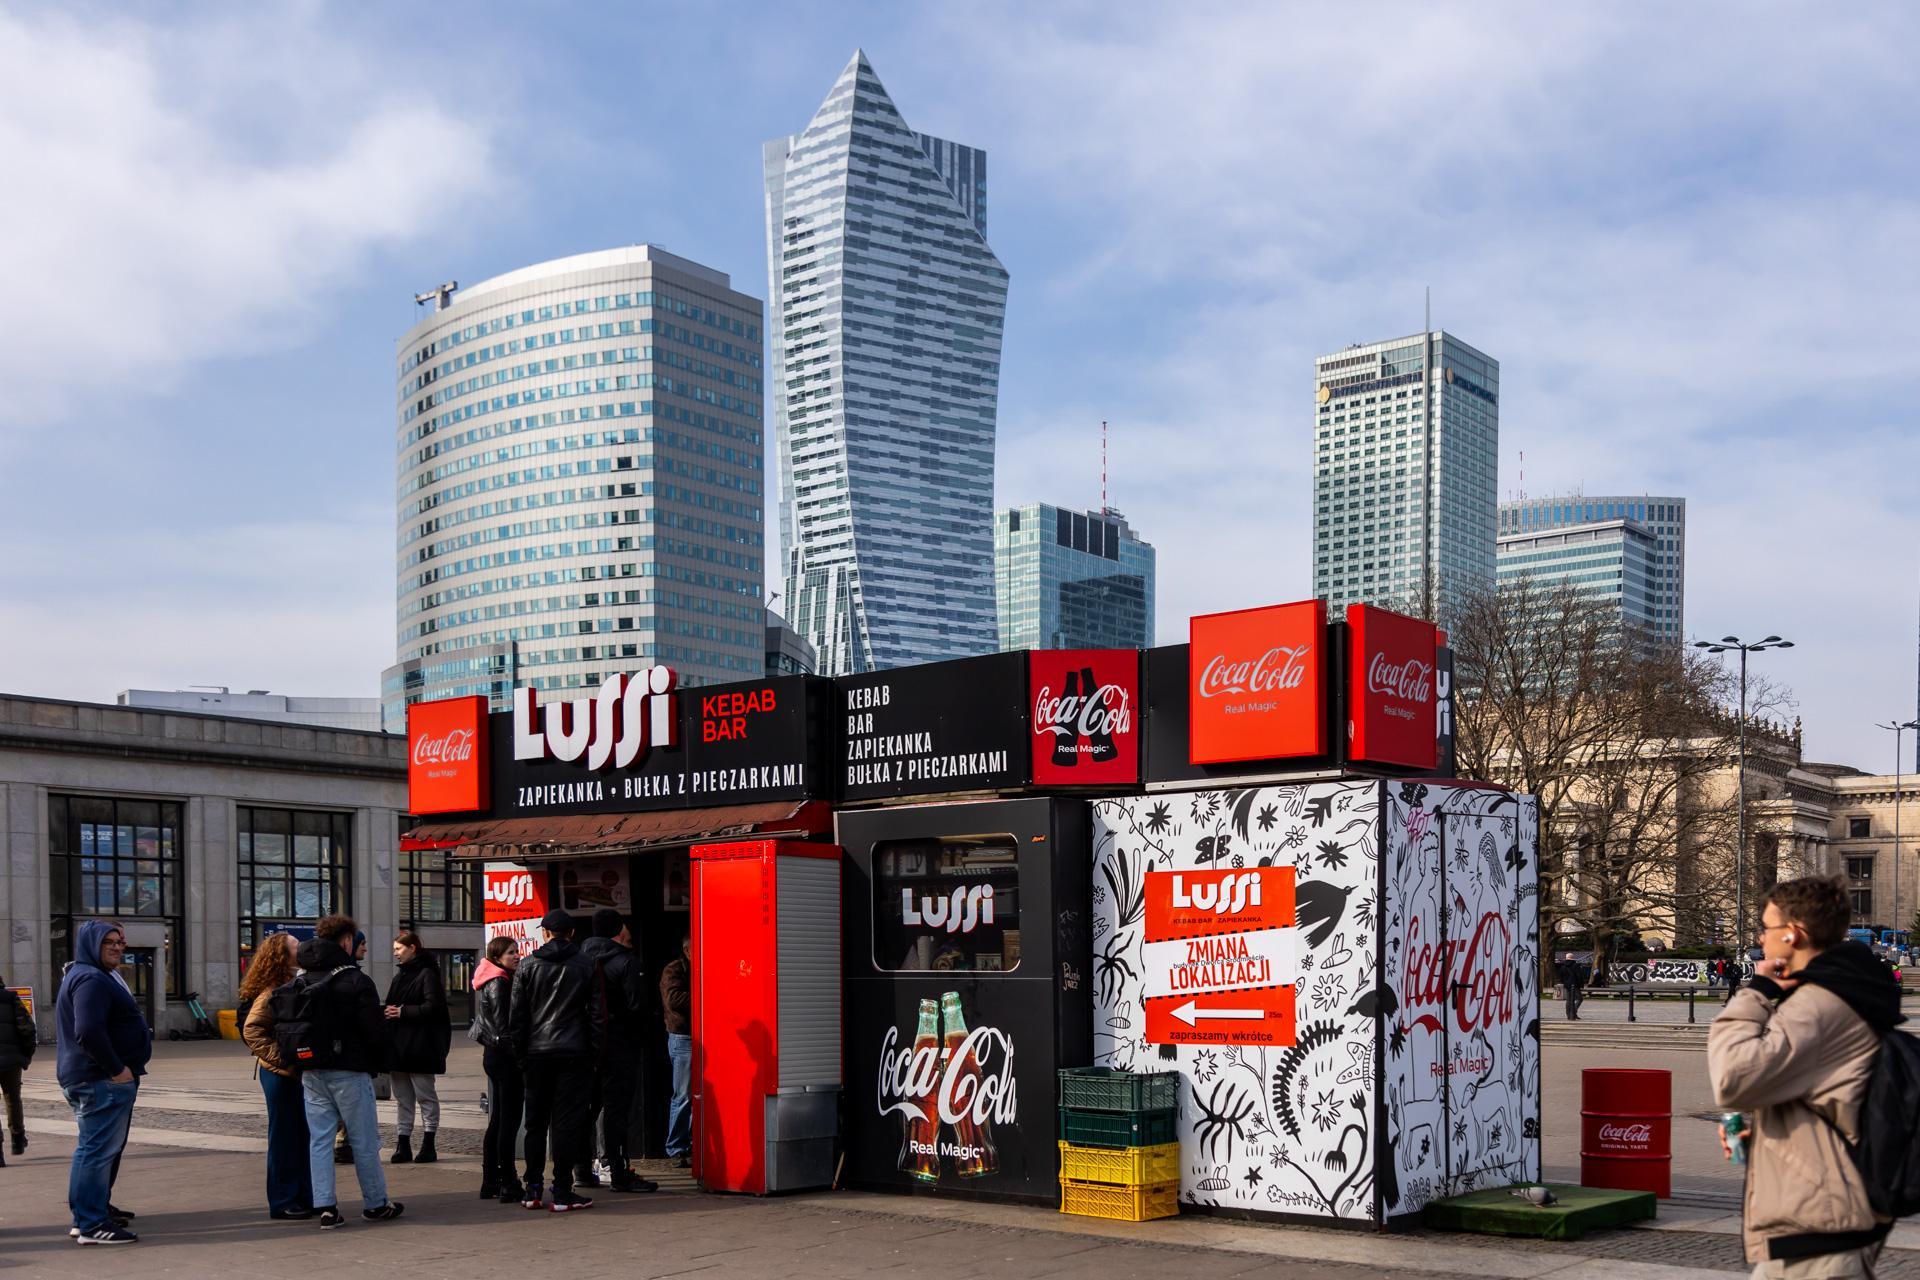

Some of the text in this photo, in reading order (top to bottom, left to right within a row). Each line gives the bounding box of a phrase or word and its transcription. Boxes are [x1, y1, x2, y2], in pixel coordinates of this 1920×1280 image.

[1200, 645, 1311, 697] Coca-Cola
[1368, 652, 1433, 703] Coca-Cola
[703, 689, 776, 718] KEBAB
[847, 685, 890, 710] KEBAB
[1034, 684, 1130, 736] Coca-Cola
[1224, 701, 1277, 714] Real Magic
[1384, 705, 1415, 720] Real Magic
[514, 665, 677, 771] Lussi
[703, 718, 747, 742] BAR
[848, 713, 873, 735] BAR
[414, 728, 474, 766] Coca-Cola
[848, 732, 932, 760] ZAPIEKANKA
[1058, 745, 1107, 754] Real Magic
[848, 750, 1007, 785] BUŁKA Z PIECZARKAMI
[519, 763, 803, 807] ZAPIEKANKA BUŁKA Z PIECZARKAMI
[484, 874, 533, 906] Lussi
[1172, 872, 1262, 914] Lussi
[902, 883, 995, 933] Lussi
[1186, 936, 1249, 964] ZMIANA
[1169, 959, 1271, 990] LOKALIZACJI
[1400, 911, 1513, 1035] Coca-Cola
[1170, 1031, 1273, 1042] zapraszamy wkrótce
[877, 1025, 1018, 1126] Coca-Cola
[1430, 1057, 1489, 1077] Real Magic
[1598, 1123, 1652, 1141] Coca-Cola
[909, 1140, 980, 1160] Real Magic
